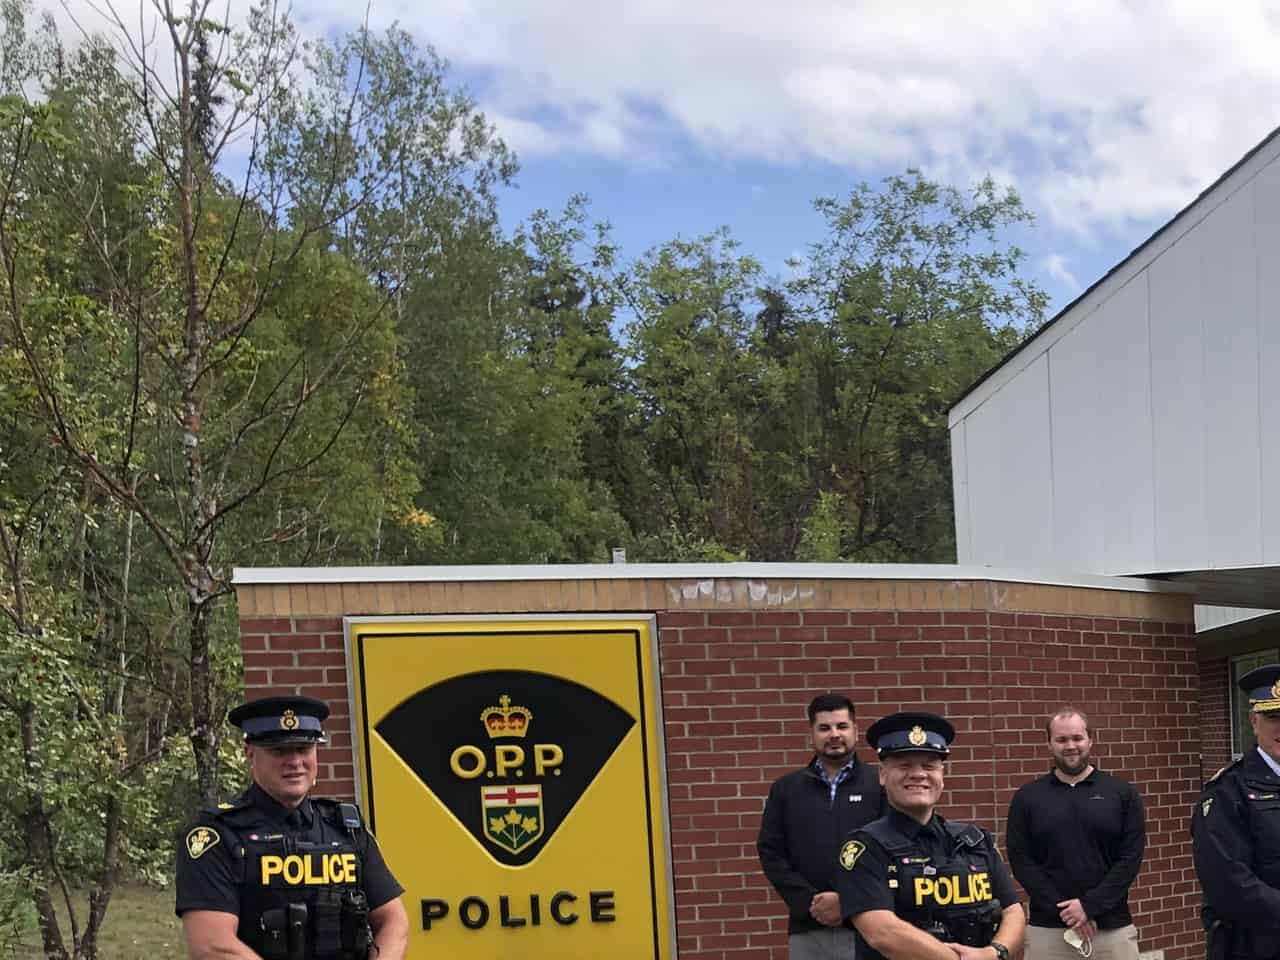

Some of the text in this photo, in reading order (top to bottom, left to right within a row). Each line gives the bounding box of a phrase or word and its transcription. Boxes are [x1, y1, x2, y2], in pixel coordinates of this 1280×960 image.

[450, 743, 564, 779] O.P.P.
[261, 853, 357, 885] POLICE
[914, 872, 992, 906] POLICE
[420, 890, 616, 931] POLICE
